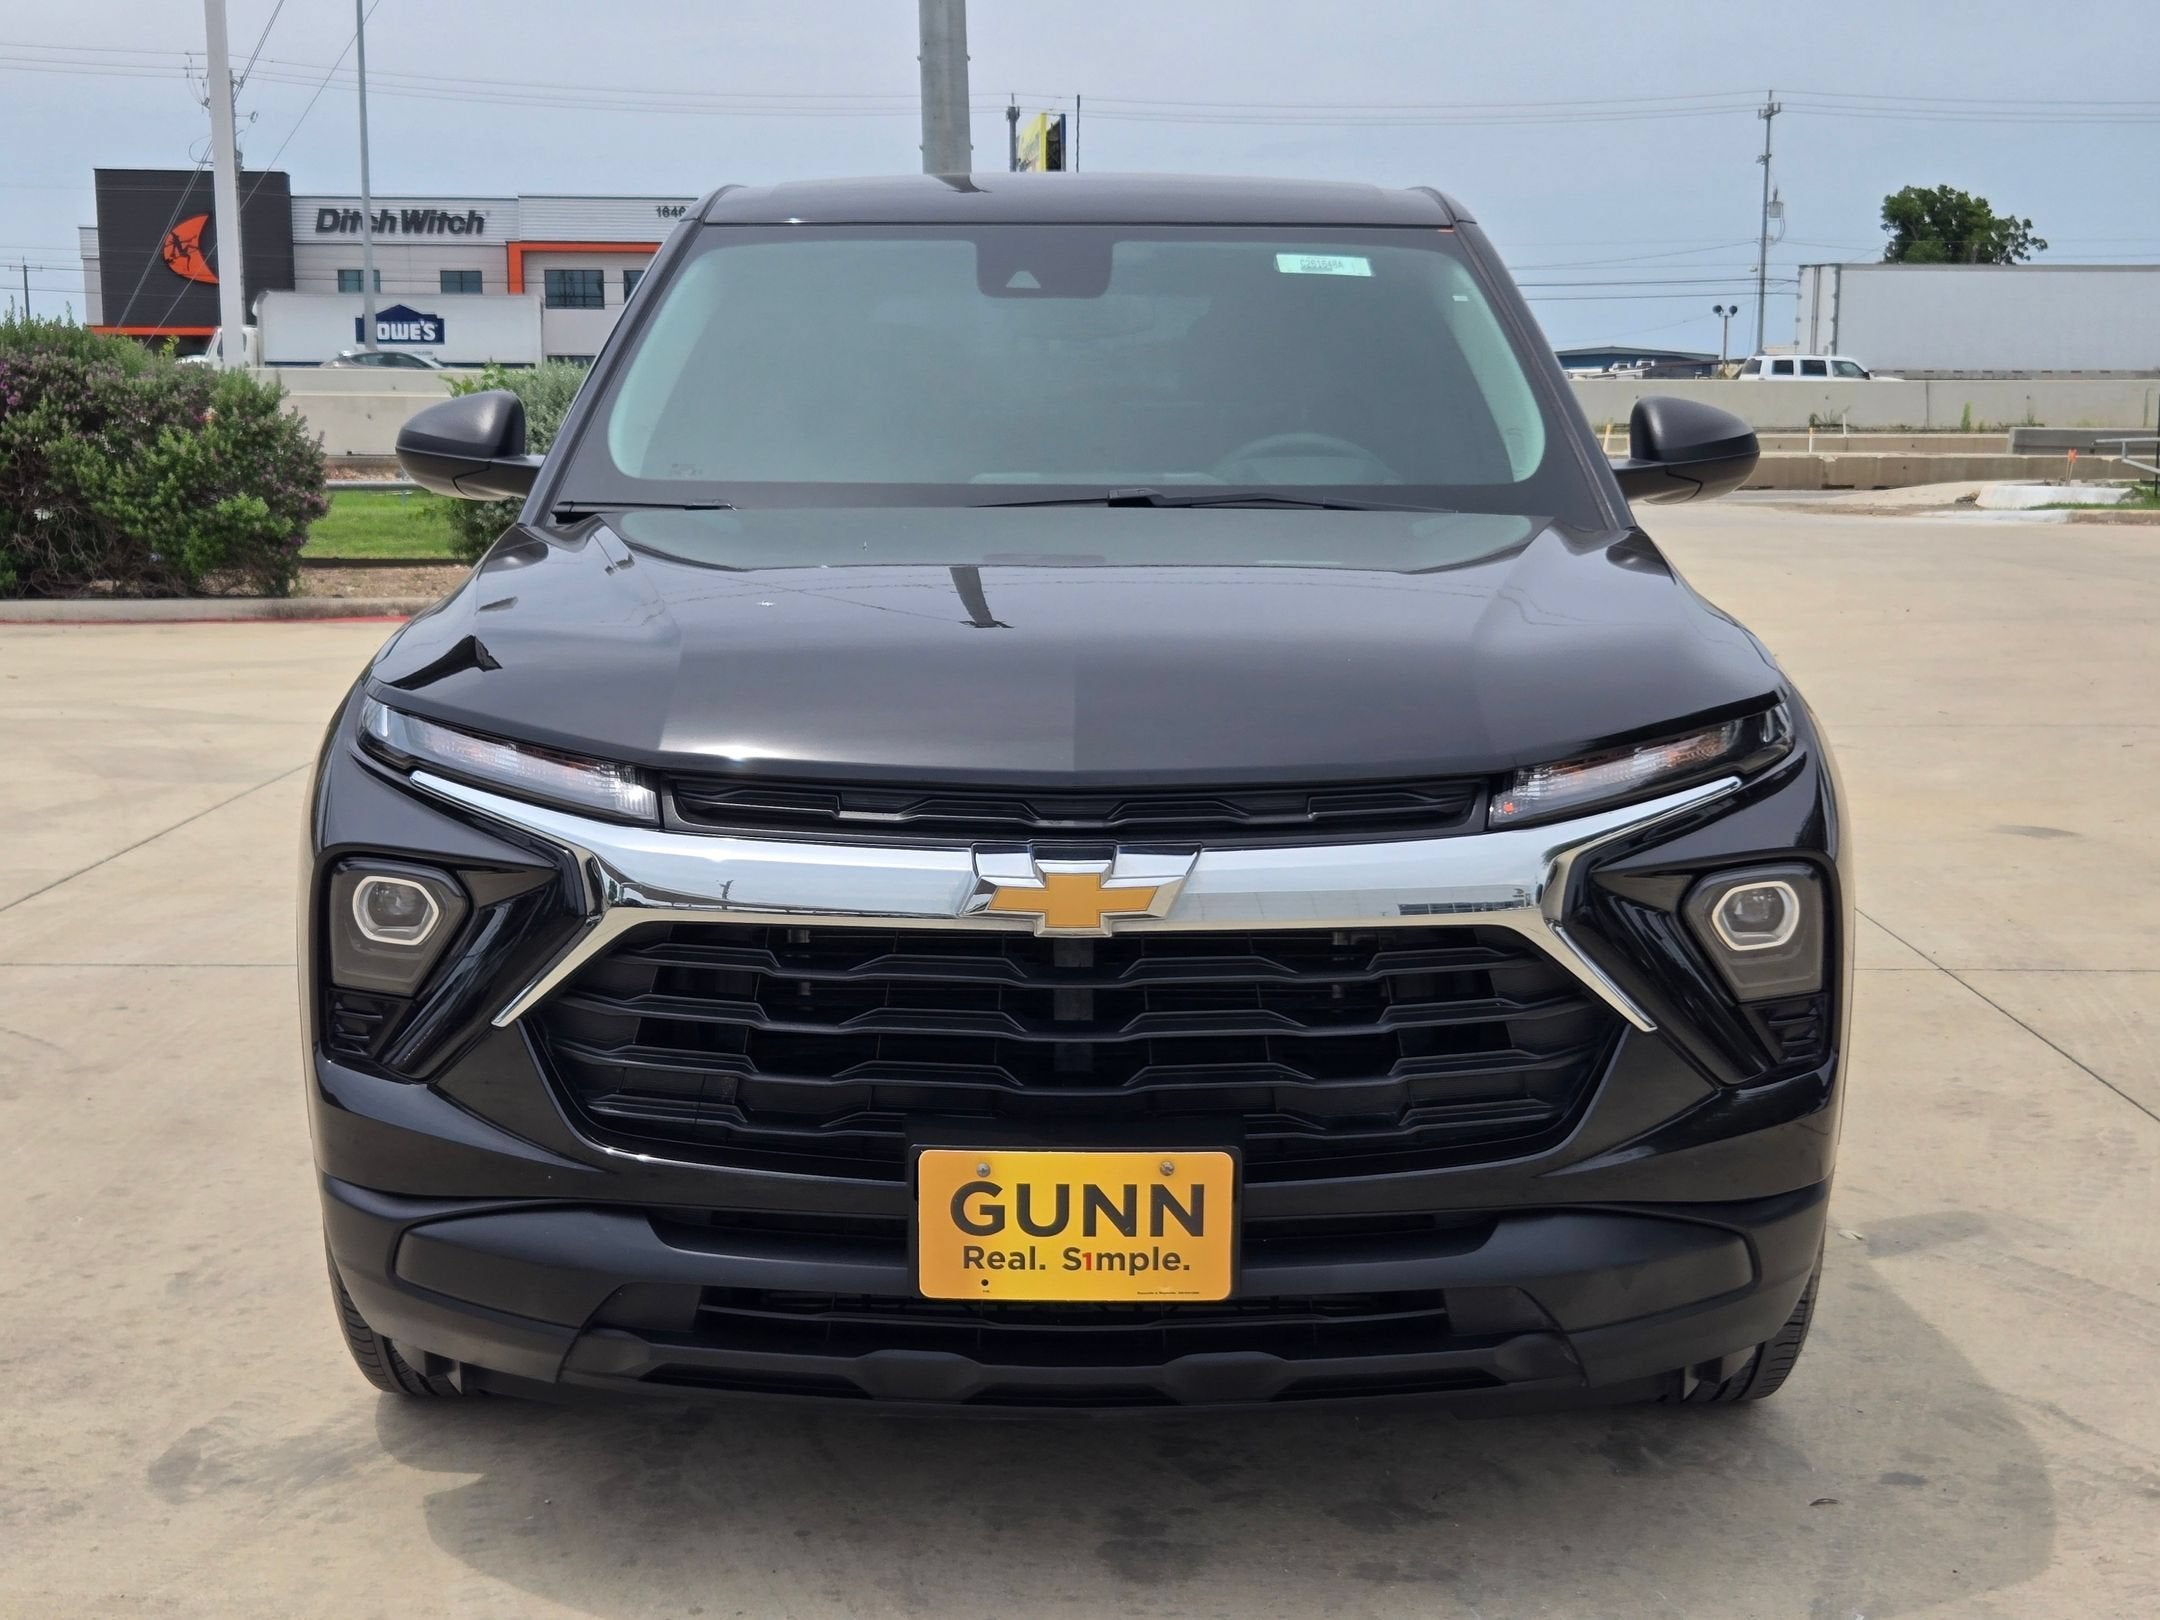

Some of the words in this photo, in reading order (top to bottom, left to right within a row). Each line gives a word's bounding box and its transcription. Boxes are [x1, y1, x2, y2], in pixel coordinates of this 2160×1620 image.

[401, 209, 485, 234] Witch
[376, 320, 437, 341] OWE'S
[950, 1180, 1205, 1237] GUNN
[963, 1246, 1047, 1270] Real.
[1062, 1246, 1190, 1276] S1mple.
